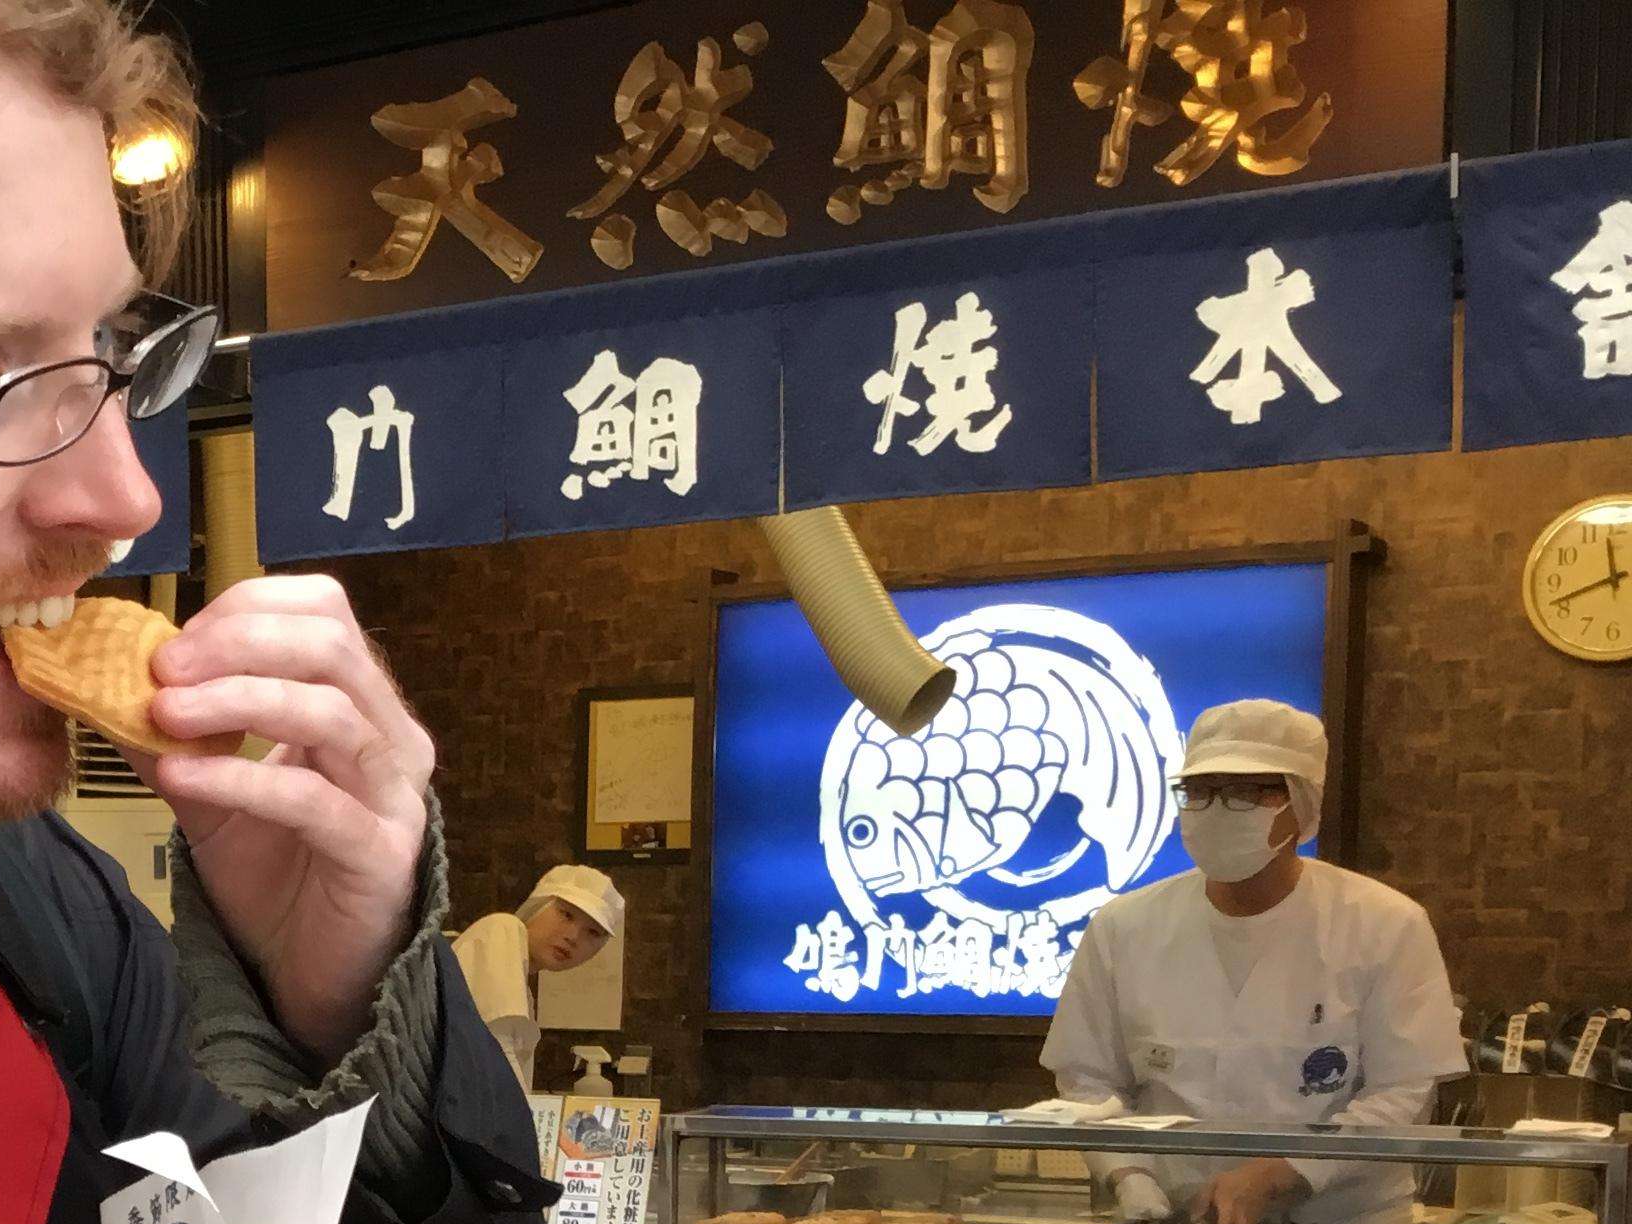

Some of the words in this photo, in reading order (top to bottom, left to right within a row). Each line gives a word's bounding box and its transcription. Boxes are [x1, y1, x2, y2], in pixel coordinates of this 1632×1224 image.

[1558, 546, 1578, 567] 10
[1547, 572, 1562, 593] 9
[1580, 616, 1594, 636] 7
[1606, 620, 1620, 641] 6
